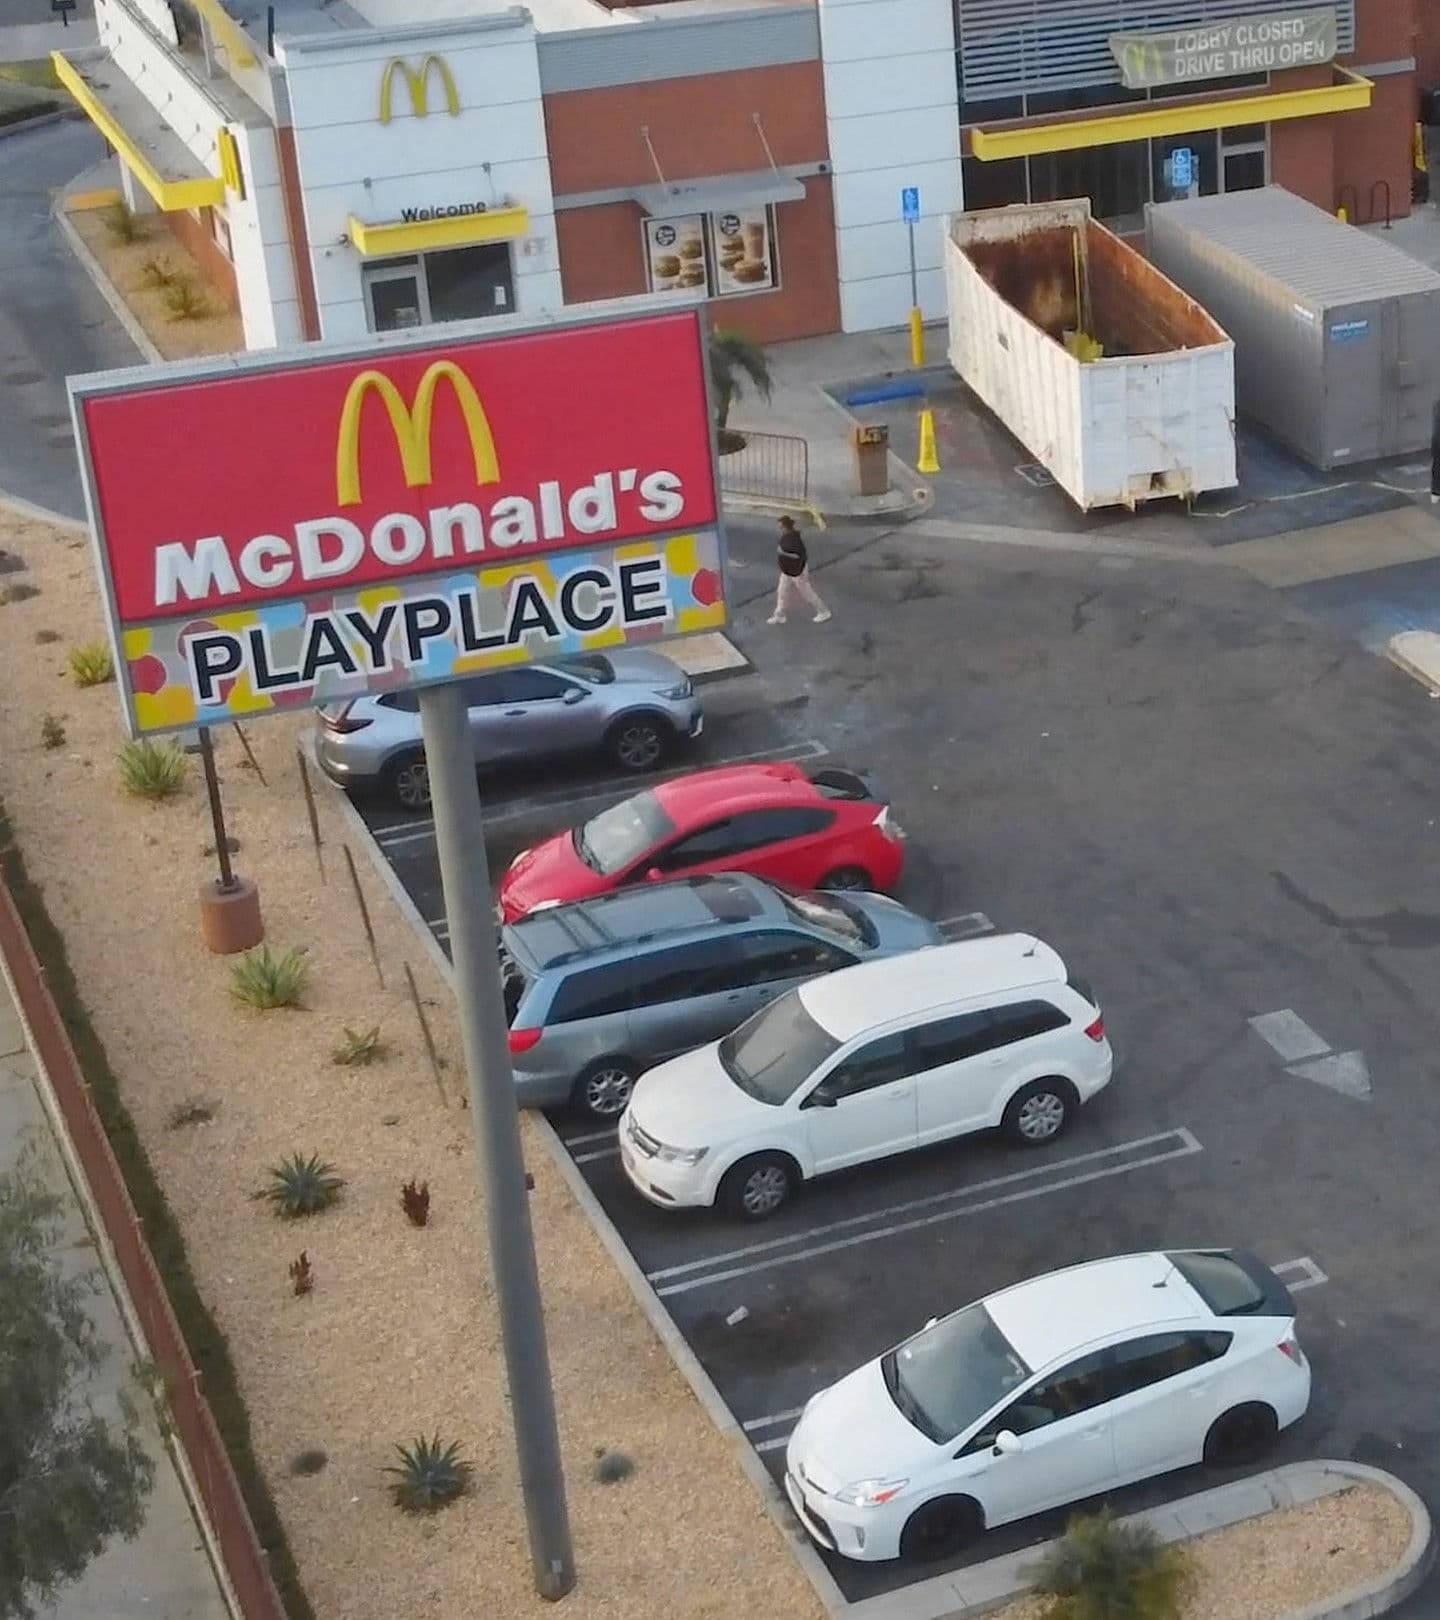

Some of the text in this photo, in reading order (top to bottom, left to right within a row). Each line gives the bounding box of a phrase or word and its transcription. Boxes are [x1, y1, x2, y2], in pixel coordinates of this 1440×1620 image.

[1174, 19, 1305, 53] LOBBY CLOSED
[1174, 40, 1326, 78] DRIVE THRU OPEN
[401, 201, 486, 223] Welcome
[154, 469, 685, 606] McDonald's
[191, 558, 669, 700] PLAYPLACE
